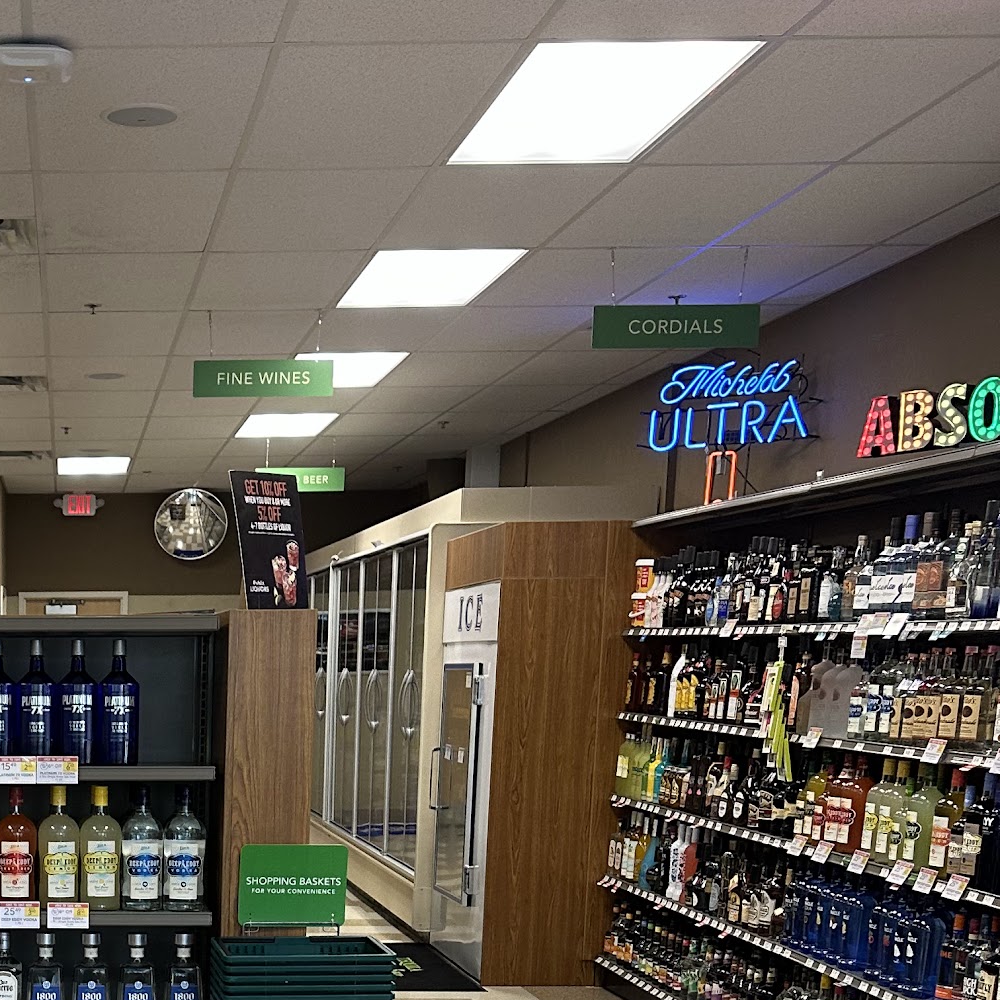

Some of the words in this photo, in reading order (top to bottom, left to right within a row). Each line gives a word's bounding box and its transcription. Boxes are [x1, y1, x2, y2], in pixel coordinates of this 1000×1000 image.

[628, 318, 723, 335] CORDIALS
[216, 371, 251, 387] FINE
[256, 370, 311, 386] WINES
[648, 394, 808, 453] ULTRA
[244, 479, 258, 495] GET
[260, 480, 274, 496] 10%
[274, 481, 287, 497] OFF
[303, 475, 328, 484] BEER
[68, 495, 92, 515] EXIT
[257, 505, 268, 521] 5%
[268, 506, 281, 522] OFF
[458, 593, 483, 632] ICE
[246, 876, 296, 886] SHOPPING
[299, 877, 342, 886] BASKETS
[36, 992, 56, 1000] 1800
[81, 992, 102, 1000] 1800
[128, 993, 148, 1000] 1800
[174, 993, 194, 1000] 1800
